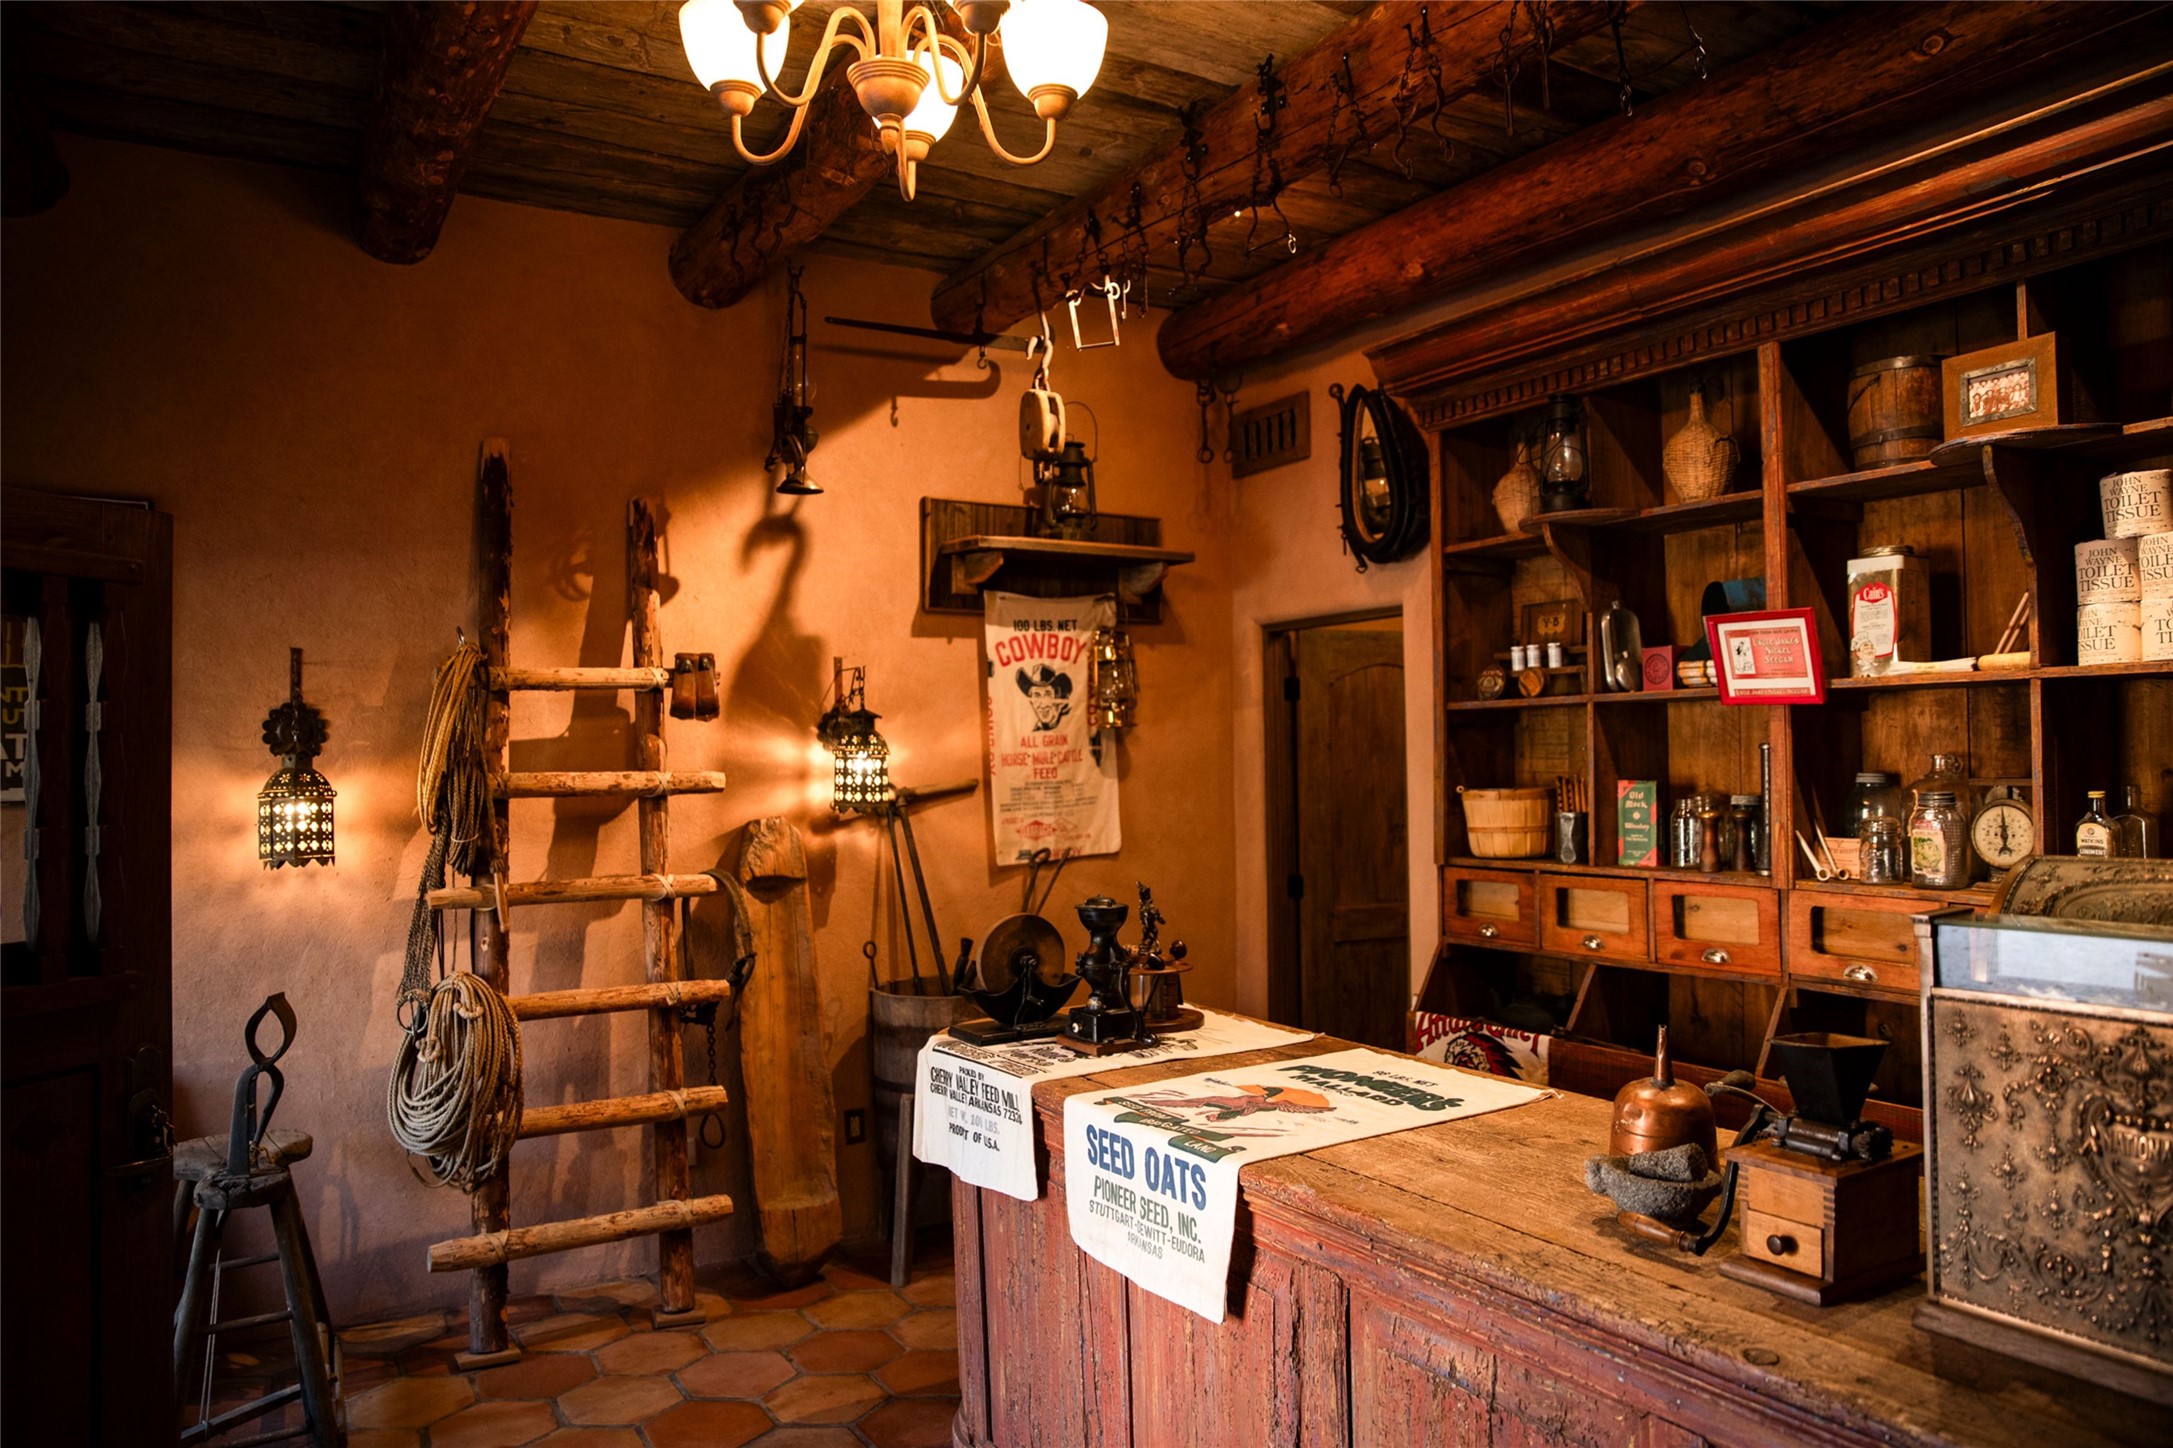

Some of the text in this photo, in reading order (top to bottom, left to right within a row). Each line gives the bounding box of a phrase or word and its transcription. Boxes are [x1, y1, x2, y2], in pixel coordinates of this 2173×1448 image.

[2112, 475, 2141, 488] JOHN
[2109, 483, 2148, 497] WAYNE
[2104, 490, 2162, 511] TOILET
[2105, 504, 2162, 523] TISSUE
[2089, 547, 2118, 558] JOHN
[2085, 556, 2123, 566] WAYNE
[2078, 563, 2136, 580] TOILET
[2079, 576, 2135, 592] TISSUE
[1863, 586, 1885, 600] Cain's
[1013, 619, 1078, 632] 100 LBS. NET
[995, 633, 1087, 667] COWBOY
[1020, 734, 1068, 748] ALL GRAIN
[1033, 767, 1058, 780] FEED
[1629, 791, 1644, 800] Old
[959, 1066, 977, 1078] PACKED
[978, 1072, 984, 1081] BY
[930, 1066, 953, 1088] CHERRY
[981, 1083, 1000, 1104] FEED
[1001, 1089, 1020, 1112] MILL
[968, 1096, 1002, 1117] ARKANSAS
[972, 1131, 982, 1144] OF
[1183, 1139, 1218, 1154] LAND
[1086, 1124, 1207, 1211] SEED OATS
[1093, 1175, 1202, 1244] PIONEER SEED, INC.
[1127, 1232, 1164, 1260] ARKANSAS
